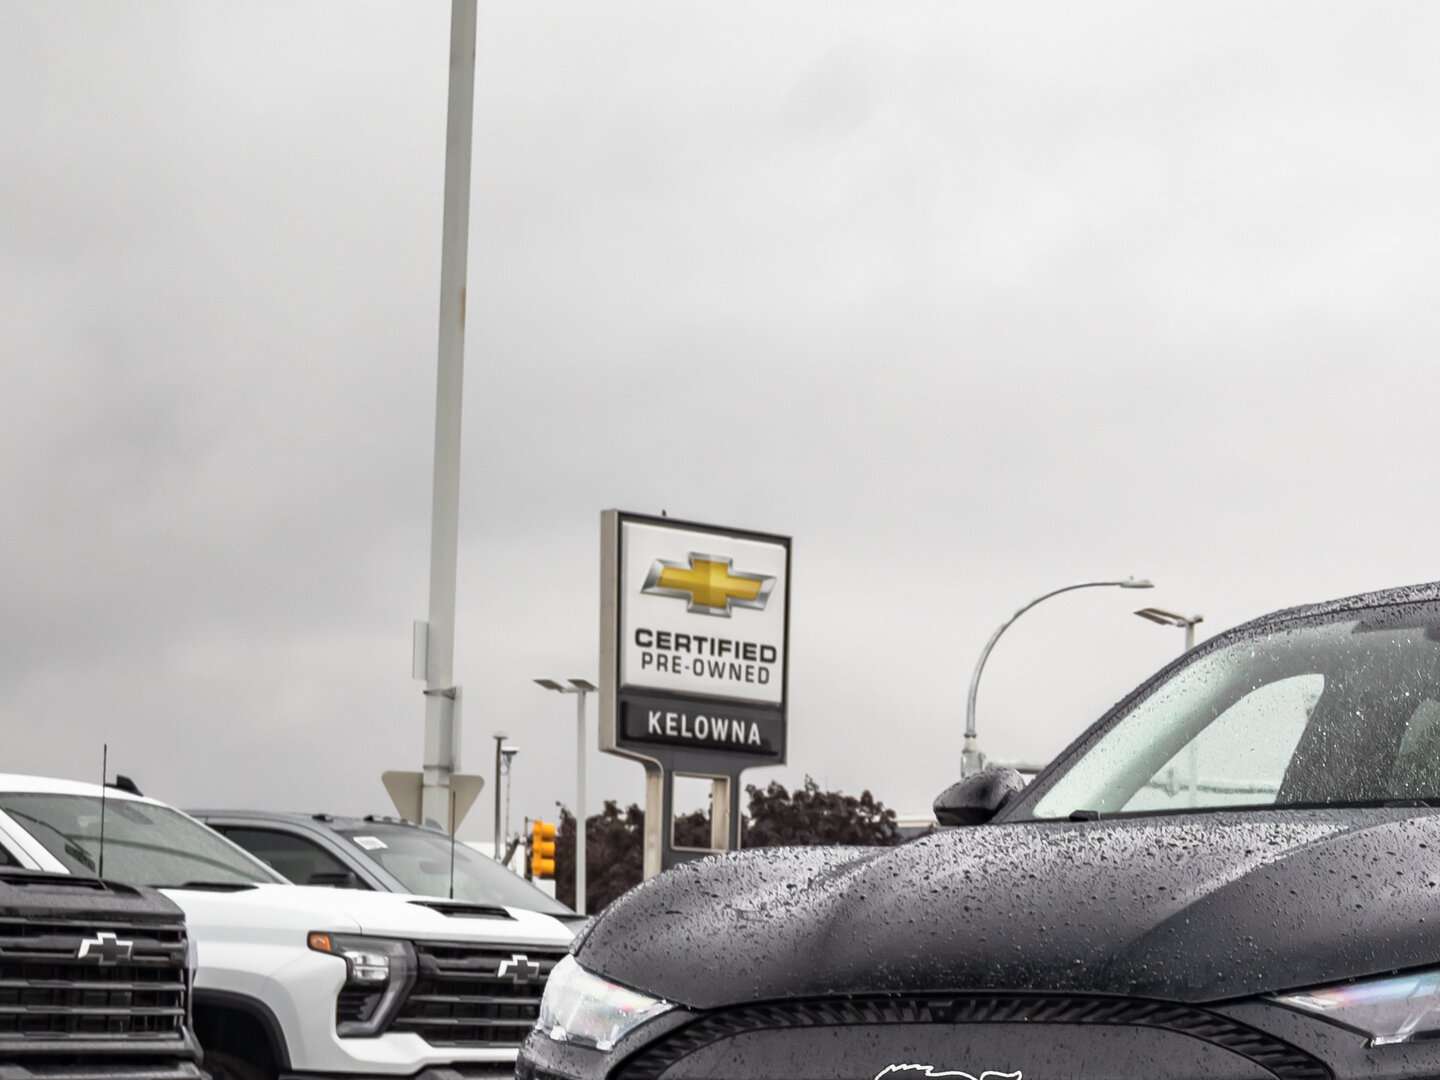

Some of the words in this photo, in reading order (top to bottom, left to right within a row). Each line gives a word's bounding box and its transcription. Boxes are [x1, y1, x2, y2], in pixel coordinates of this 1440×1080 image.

[635, 627, 777, 665] CERTIFIED
[641, 651, 770, 685] PRE-OWNED
[648, 710, 761, 746] KELOWNA
